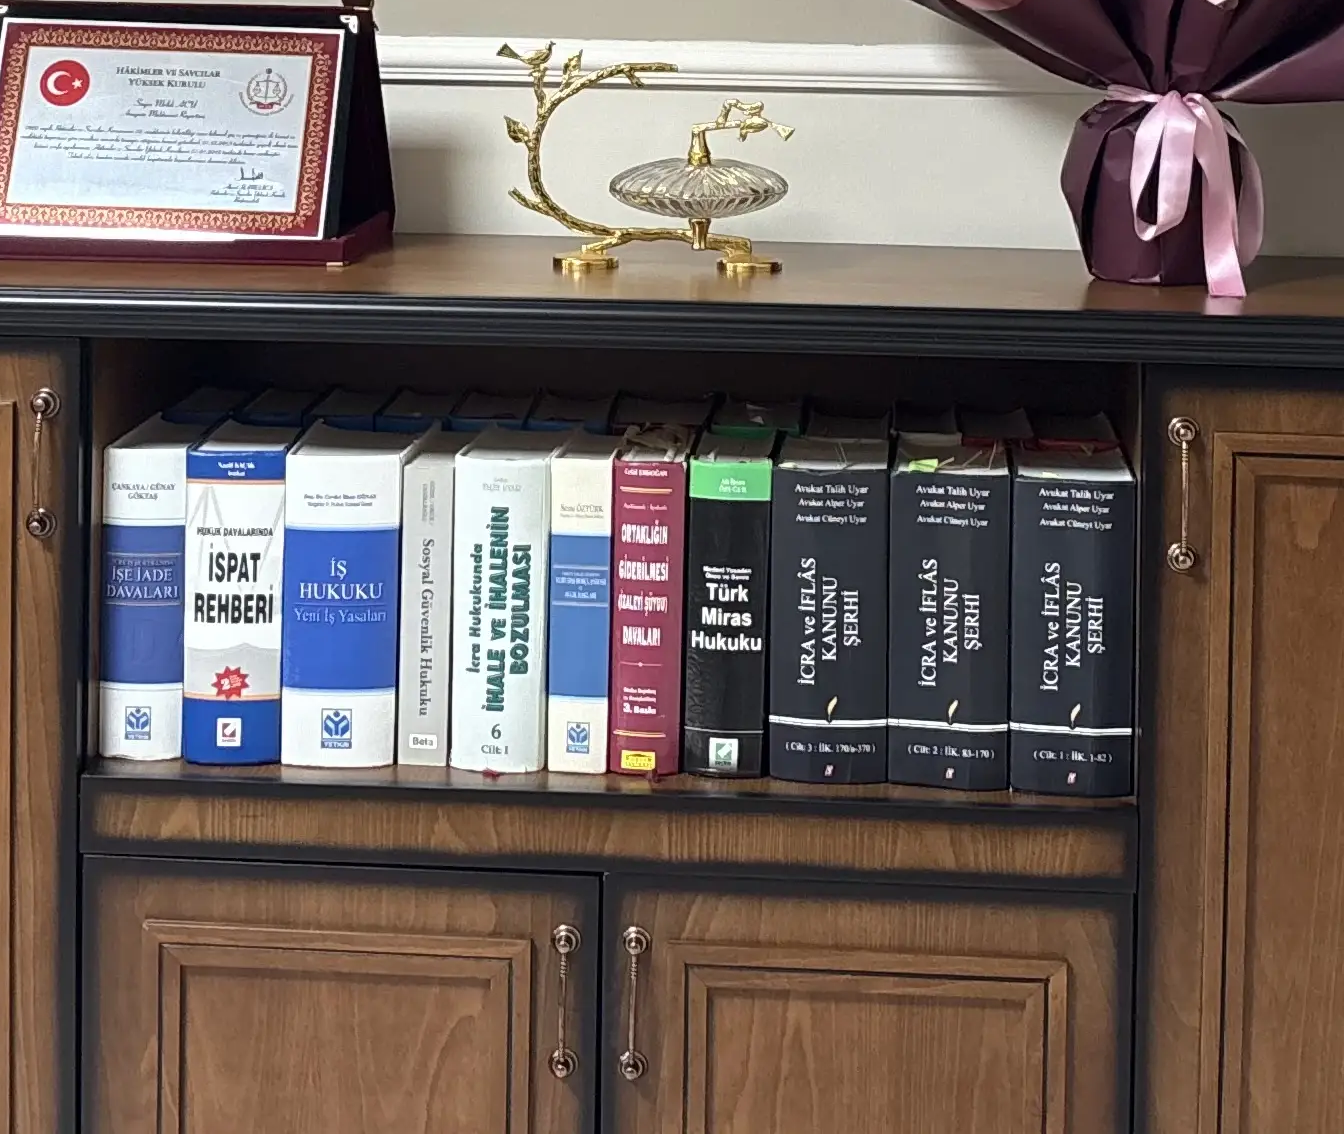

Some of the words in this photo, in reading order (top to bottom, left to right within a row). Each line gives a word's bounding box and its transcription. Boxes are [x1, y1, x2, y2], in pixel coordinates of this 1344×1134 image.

[621, 519, 668, 545] ORTAKLIĞIN
[137, 566, 173, 583] İADE
[208, 542, 261, 583] İSPAT
[330, 557, 347, 581] İŞ
[418, 538, 435, 585] Sosyal
[484, 506, 509, 610] İHALENİN
[619, 554, 669, 581] GİDERİLMESİ
[106, 584, 178, 599] DAVALARI
[194, 584, 274, 624] REHBERİ
[299, 582, 384, 600] HUKUKU
[468, 543, 483, 638] Hukukunda
[706, 583, 749, 602] Türk
[797, 557, 816, 612] İFLÂS
[918, 558, 938, 613] İFLÂS
[1041, 562, 1061, 617] İFLÂS
[294, 607, 320, 622] Yeni
[324, 607, 336, 625] İş
[338, 608, 387, 623] Yasaları
[420, 589, 434, 654] Güvenlik
[509, 544, 532, 675] BOZULMASI
[701, 607, 752, 626] Miras
[805, 616, 816, 635] ve
[821, 576, 838, 661] KANUNU
[841, 590, 862, 646] ŞERHİ
[925, 618, 937, 637] ve
[942, 578, 959, 664] KANUNU
[961, 593, 983, 651] ŞERHİ
[1065, 581, 1083, 668] KANUNU
[1085, 596, 1106, 654] ŞERHİ
[622, 625, 661, 646] DAVALARI
[691, 630, 762, 651] Hukuku
[1048, 621, 1059, 641] ve
[466, 643, 481, 673] İcra
[797, 639, 815, 686] İCRA
[917, 640, 937, 687] İCRA
[1040, 644, 1058, 691] İCRA
[419, 658, 433, 716] Hukuku
[481, 649, 506, 712] İHALE
[412, 736, 434, 746] Beta
[481, 745, 503, 754] Cilt
[491, 723, 502, 739] 6
